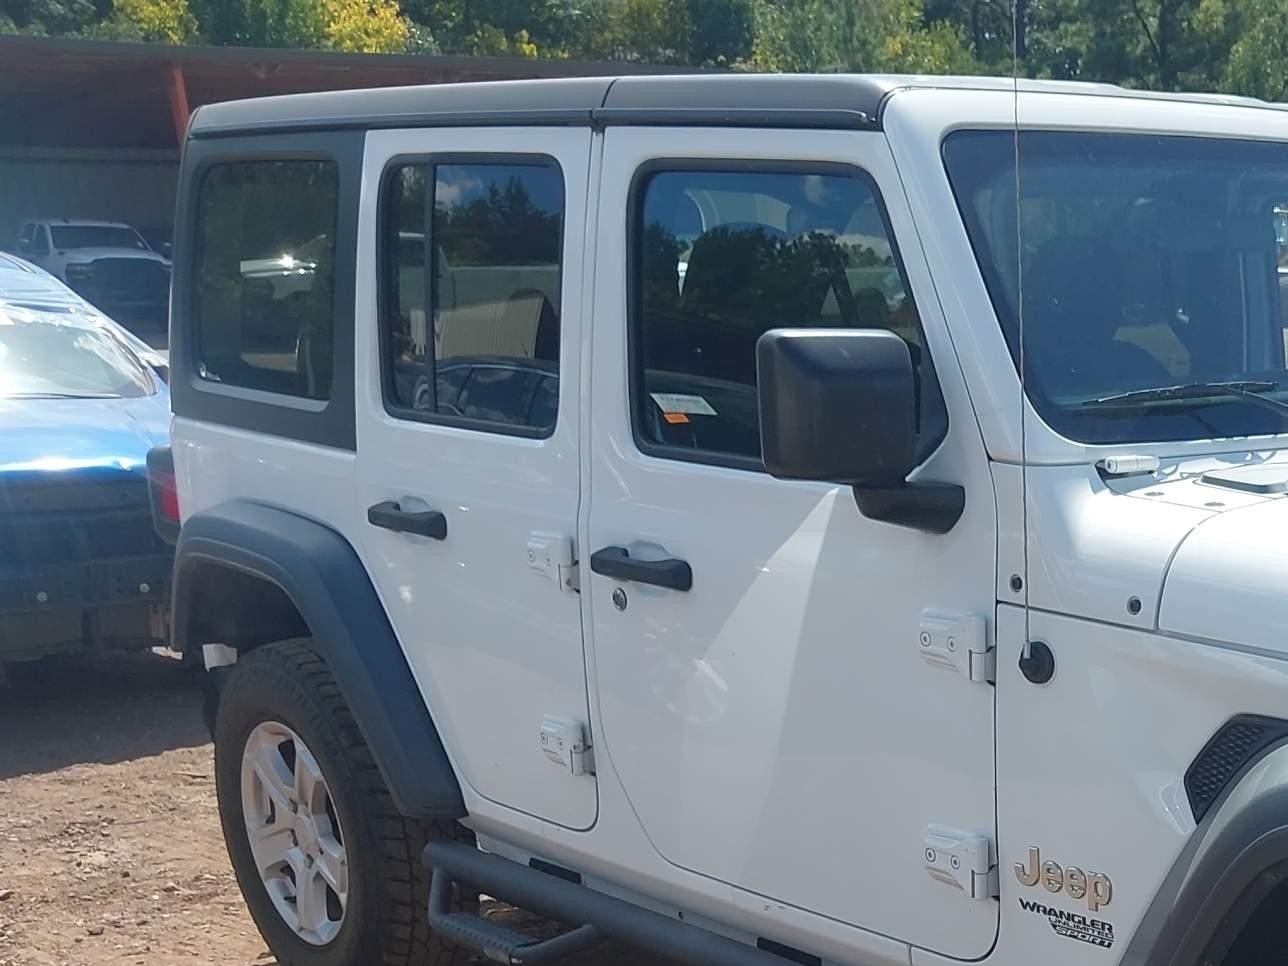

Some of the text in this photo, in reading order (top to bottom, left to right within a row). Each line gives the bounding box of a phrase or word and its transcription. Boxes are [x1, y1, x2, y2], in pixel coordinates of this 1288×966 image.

[1014, 845, 1113, 912] Jeep
[1018, 897, 1114, 934] WRANGLER
[1048, 916, 1114, 940] UNLIMITED
[1055, 925, 1113, 948] SPORT
